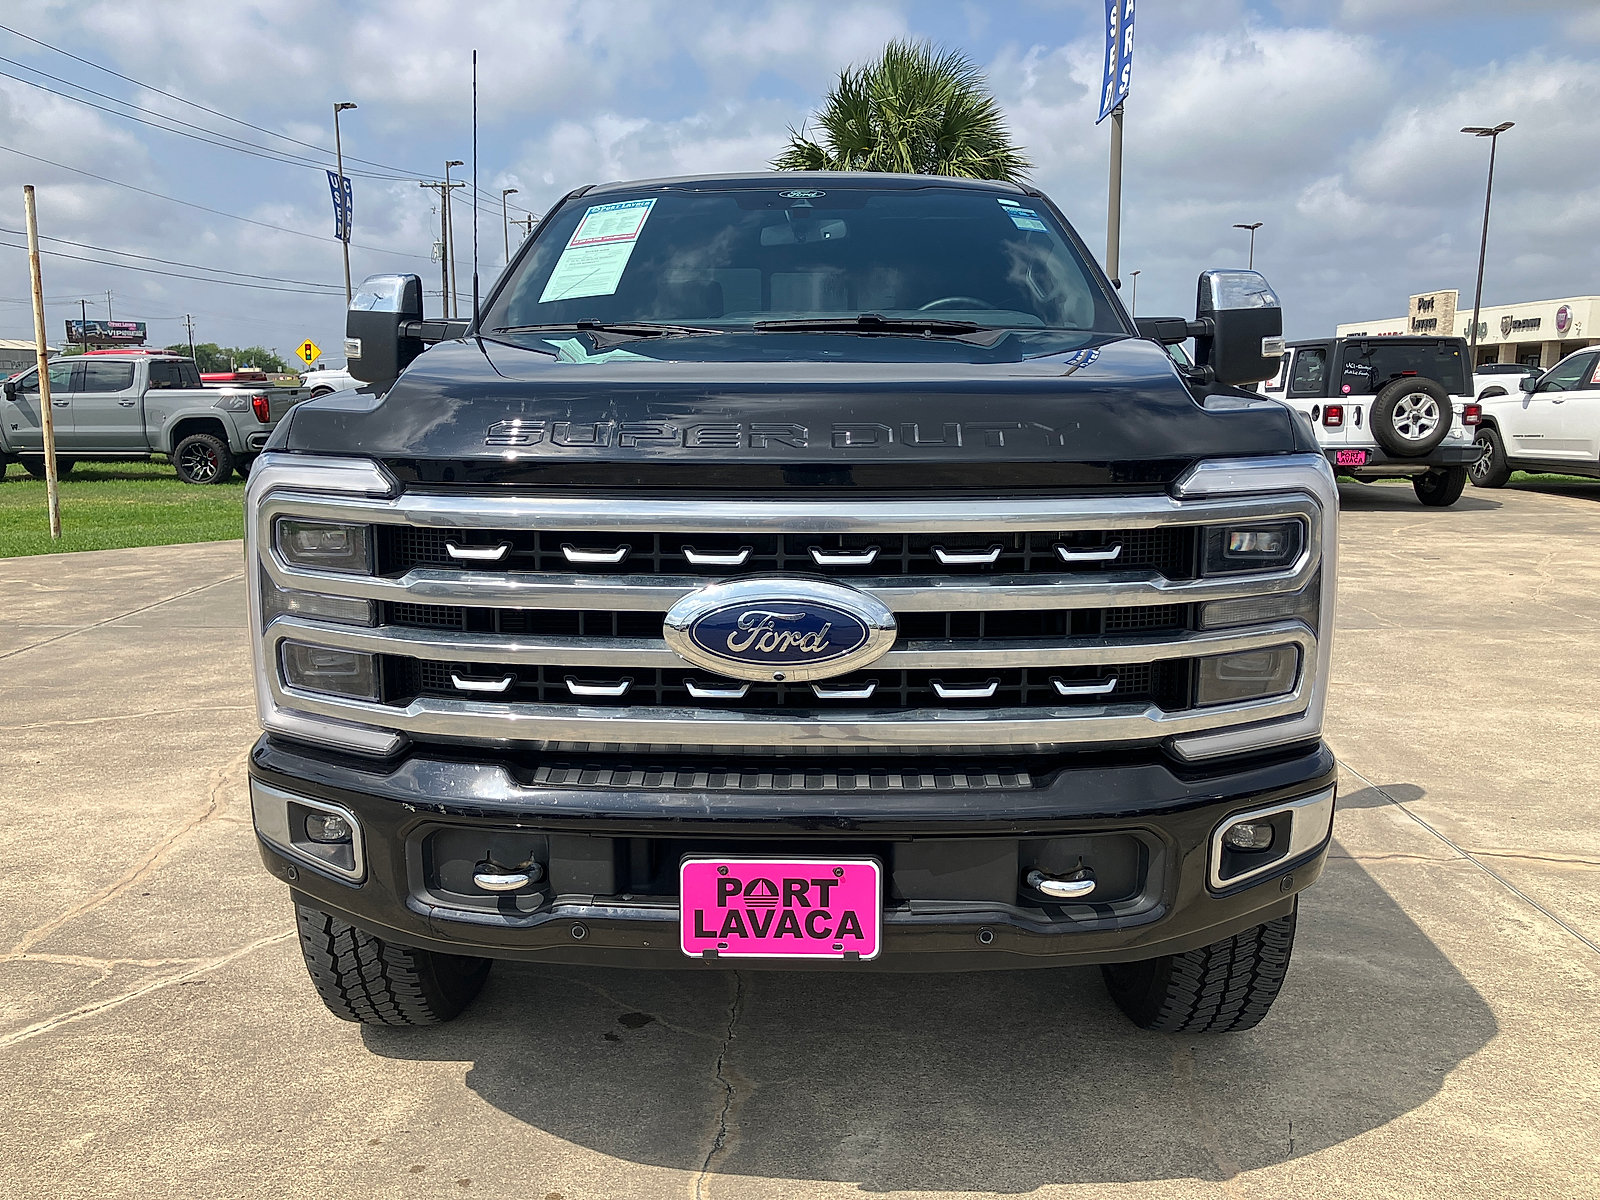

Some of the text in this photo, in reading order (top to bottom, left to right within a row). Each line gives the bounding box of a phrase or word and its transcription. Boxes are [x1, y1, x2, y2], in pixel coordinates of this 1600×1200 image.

[1102, 4, 1117, 112] SED
[329, 175, 343, 235] USED
[787, 189, 819, 198] Ford
[343, 180, 353, 239] CARS
[1417, 296, 1435, 311] Port
[1411, 316, 1438, 331] Lavaca
[485, 420, 1080, 449] SUPER DUTY
[726, 610, 832, 654] Ford
[717, 877, 839, 908] PORT
[693, 909, 865, 940] LAVACA
